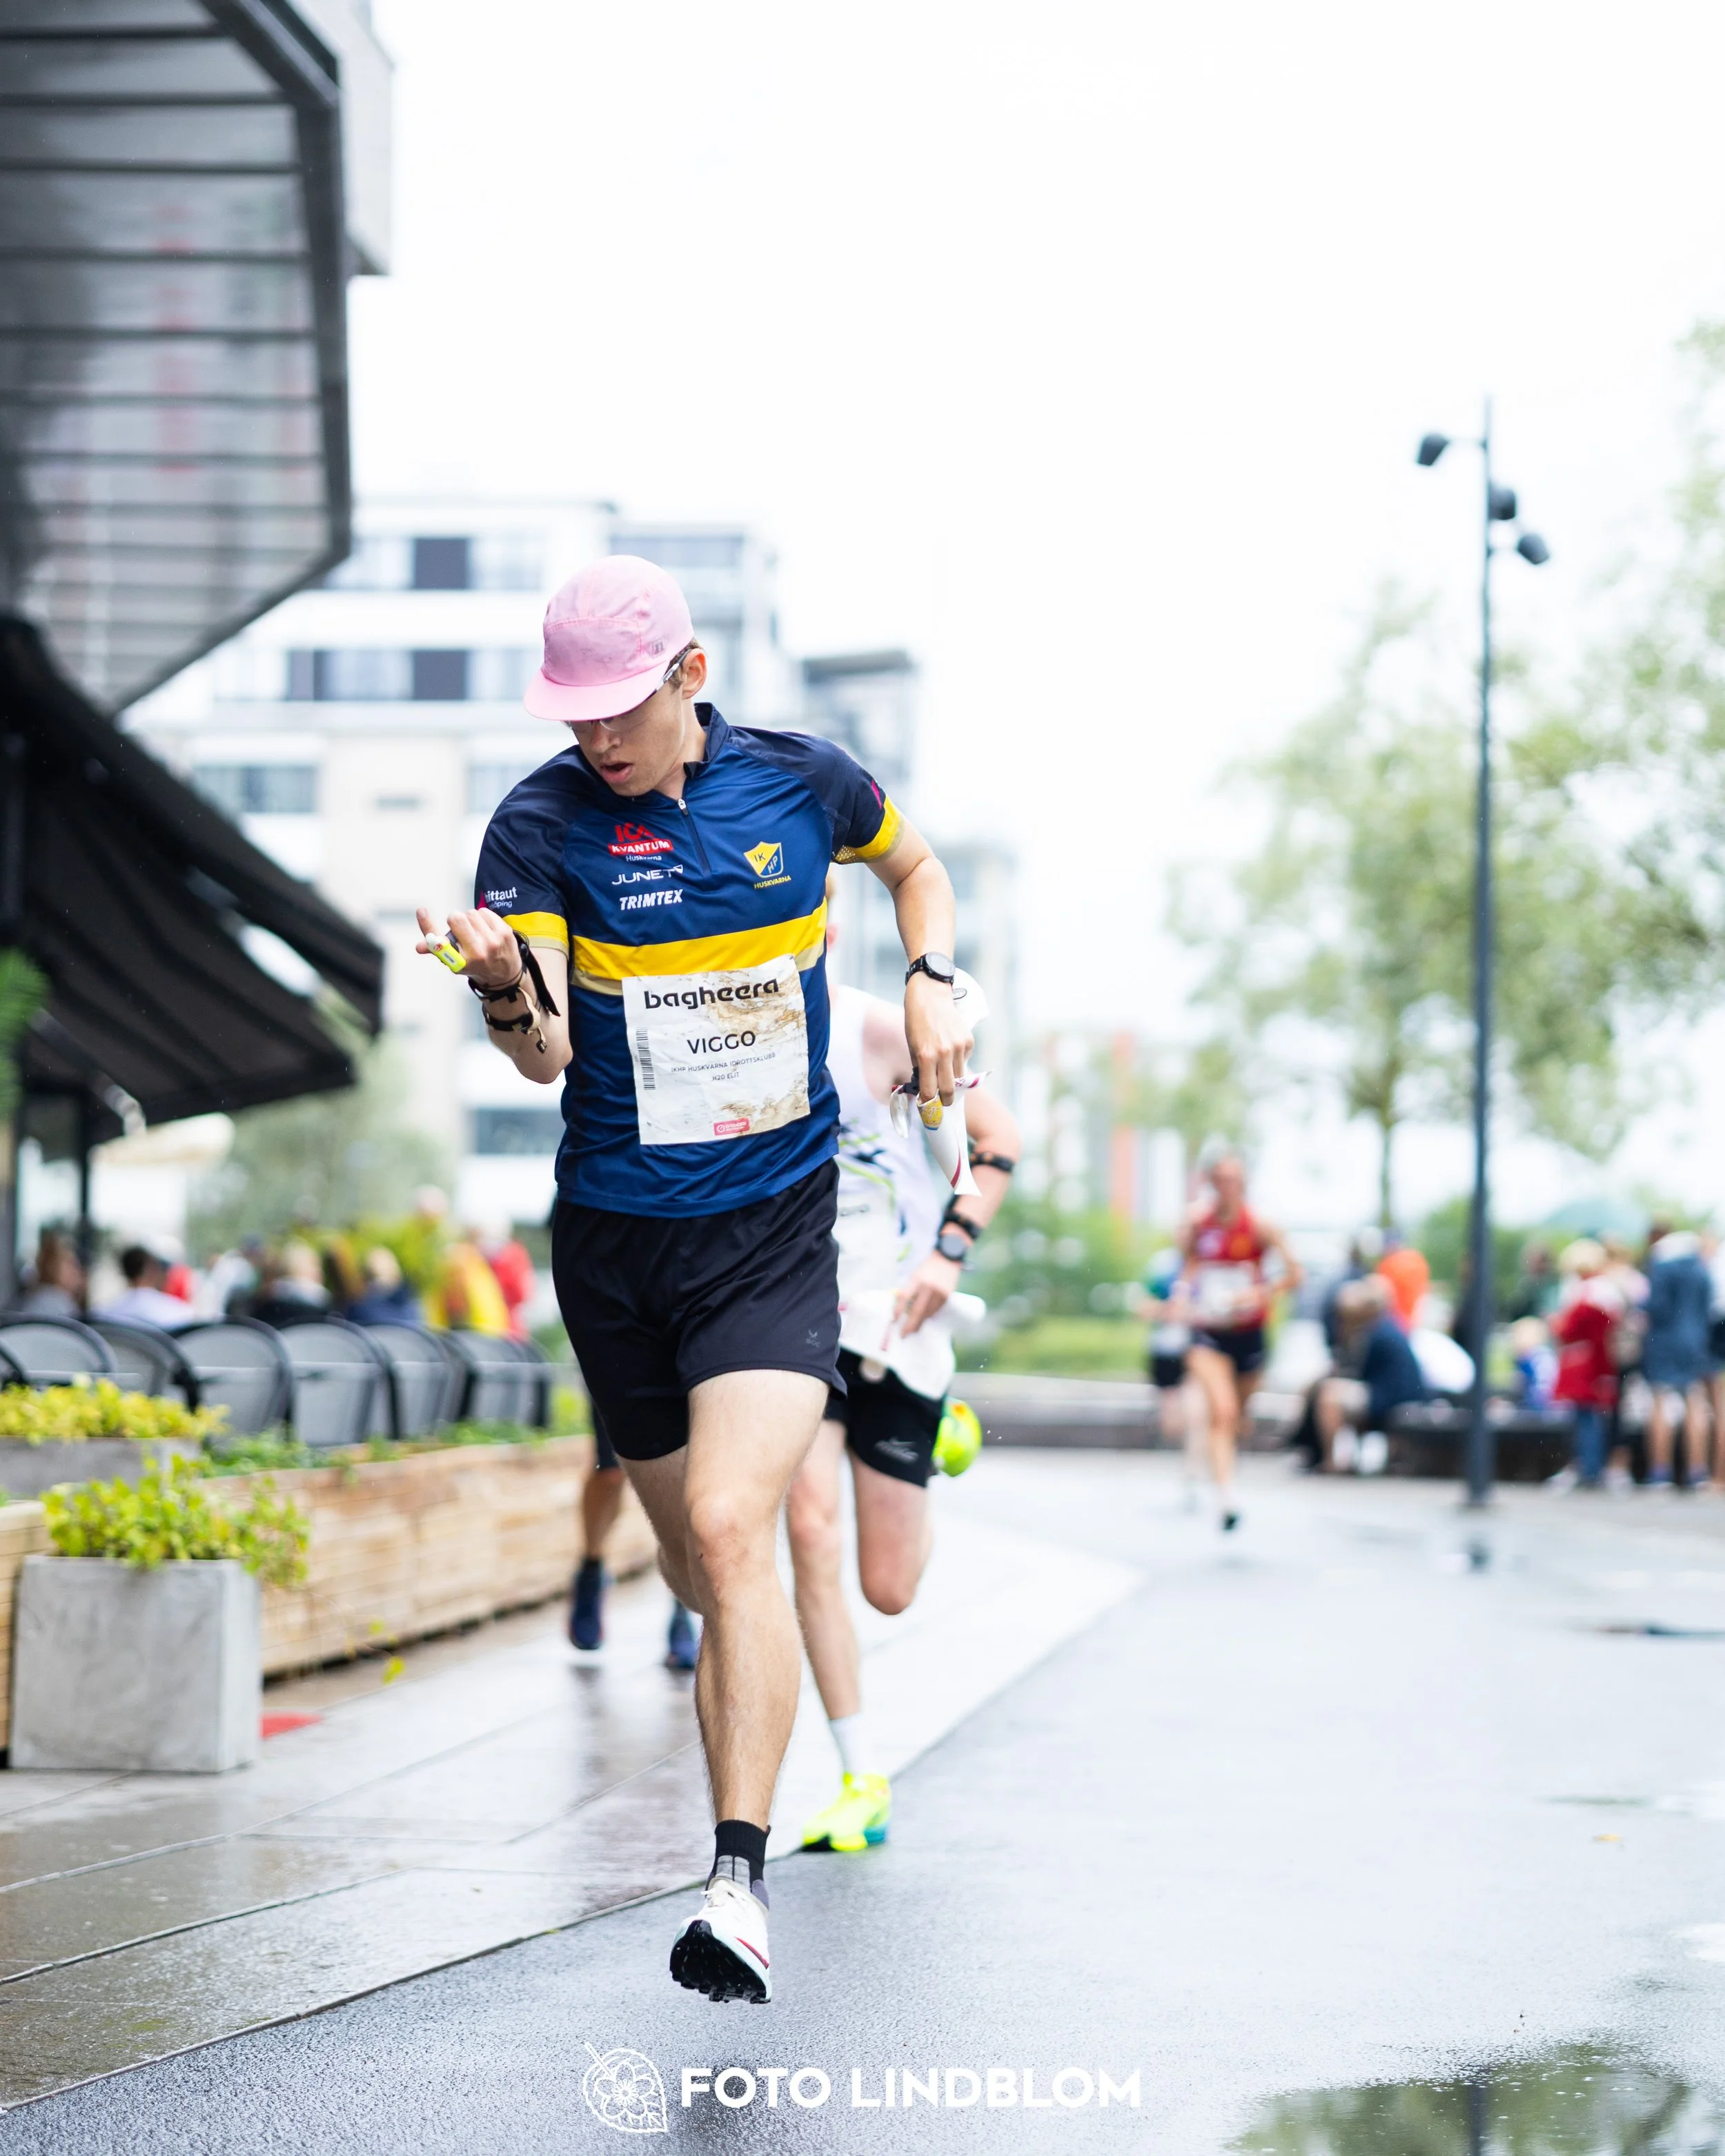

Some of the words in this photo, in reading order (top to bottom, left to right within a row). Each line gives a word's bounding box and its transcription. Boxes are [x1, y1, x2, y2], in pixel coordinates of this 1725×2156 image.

[615, 822, 655, 842] ICA
[611, 840, 670, 853] KVANTUM
[754, 852, 766, 862] IK
[767, 856, 778, 874] HP
[753, 875, 791, 889] HUSKVARNA
[620, 889, 683, 911] TRIMTEX
[644, 978, 779, 1010] bagheera
[687, 1030, 756, 1054] VIGGO
[688, 1062, 728, 1072] HUSKVARNA
[730, 1052, 776, 1067] IDROTTSKLUBB
